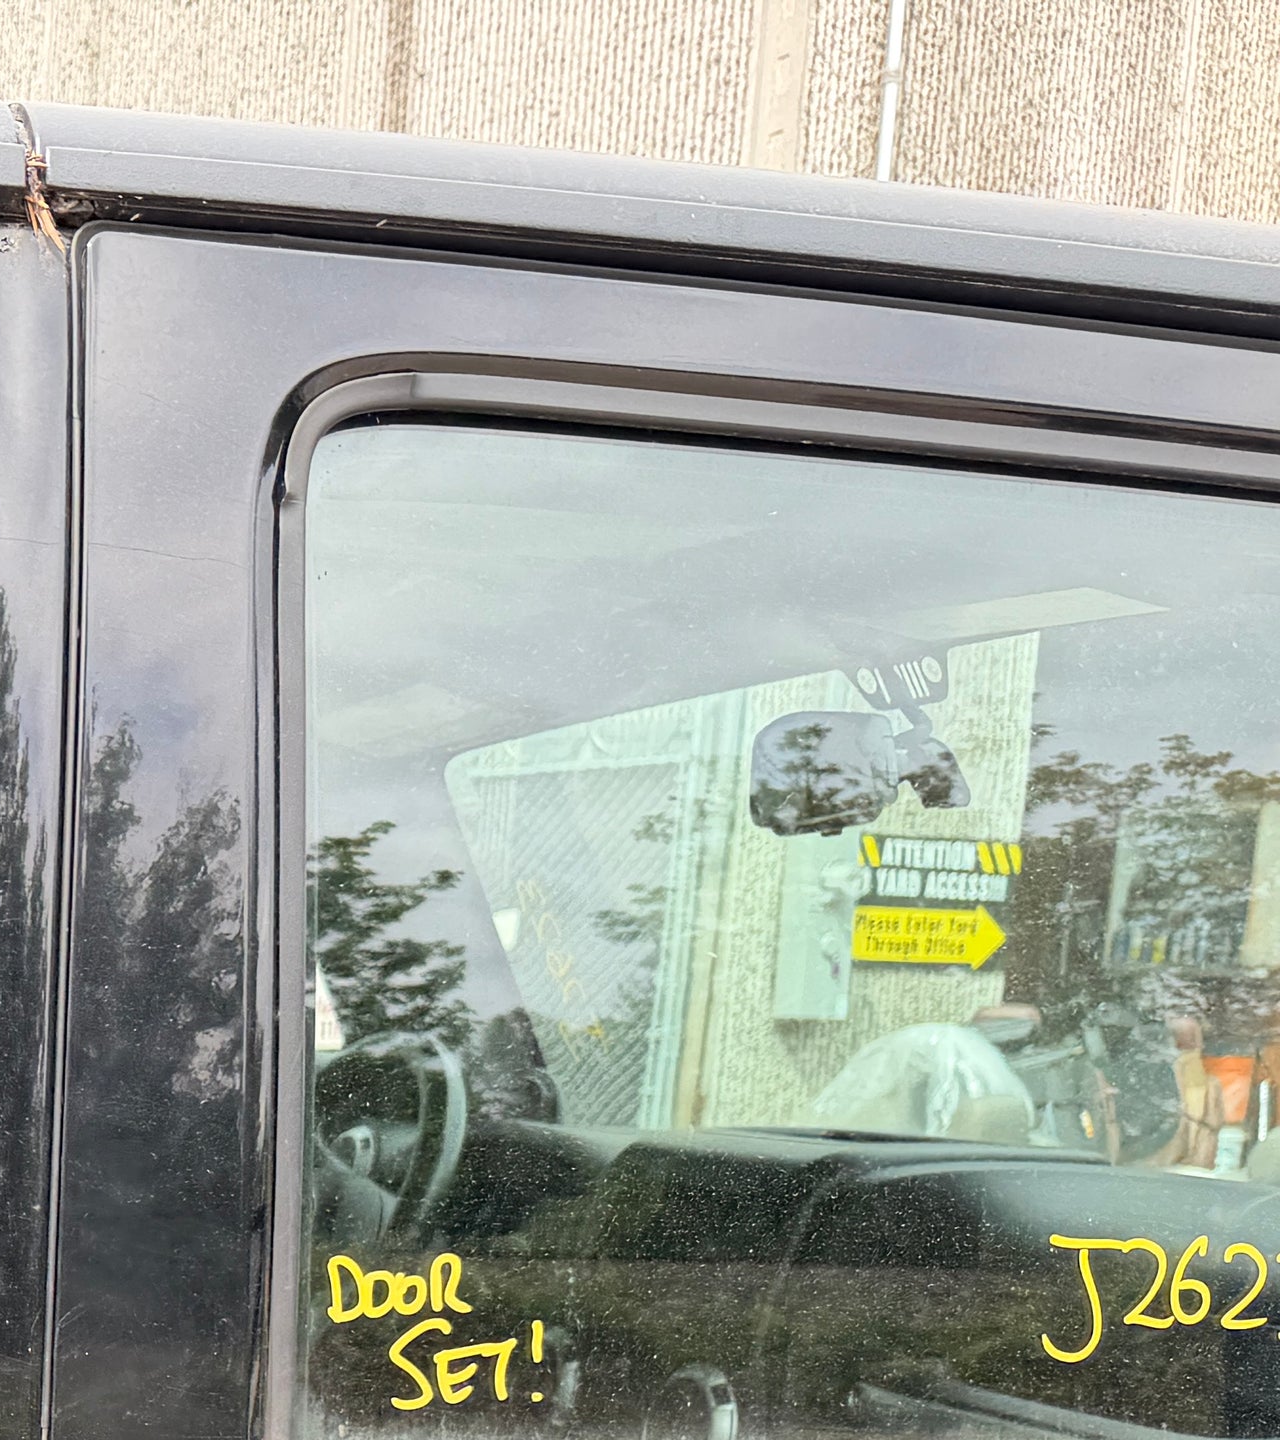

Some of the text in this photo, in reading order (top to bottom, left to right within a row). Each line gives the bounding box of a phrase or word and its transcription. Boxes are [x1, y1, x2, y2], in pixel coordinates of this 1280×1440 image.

[881, 837, 976, 871] ATTENTION
[876, 868, 989, 902] YARD ACCESS
[854, 912, 979, 937] Please Enter Yard
[865, 935, 967, 958] Through Office
[326, 1253, 473, 1324] DOOR
[1041, 1234, 1280, 1363] J262
[388, 1318, 545, 1411] SET!
